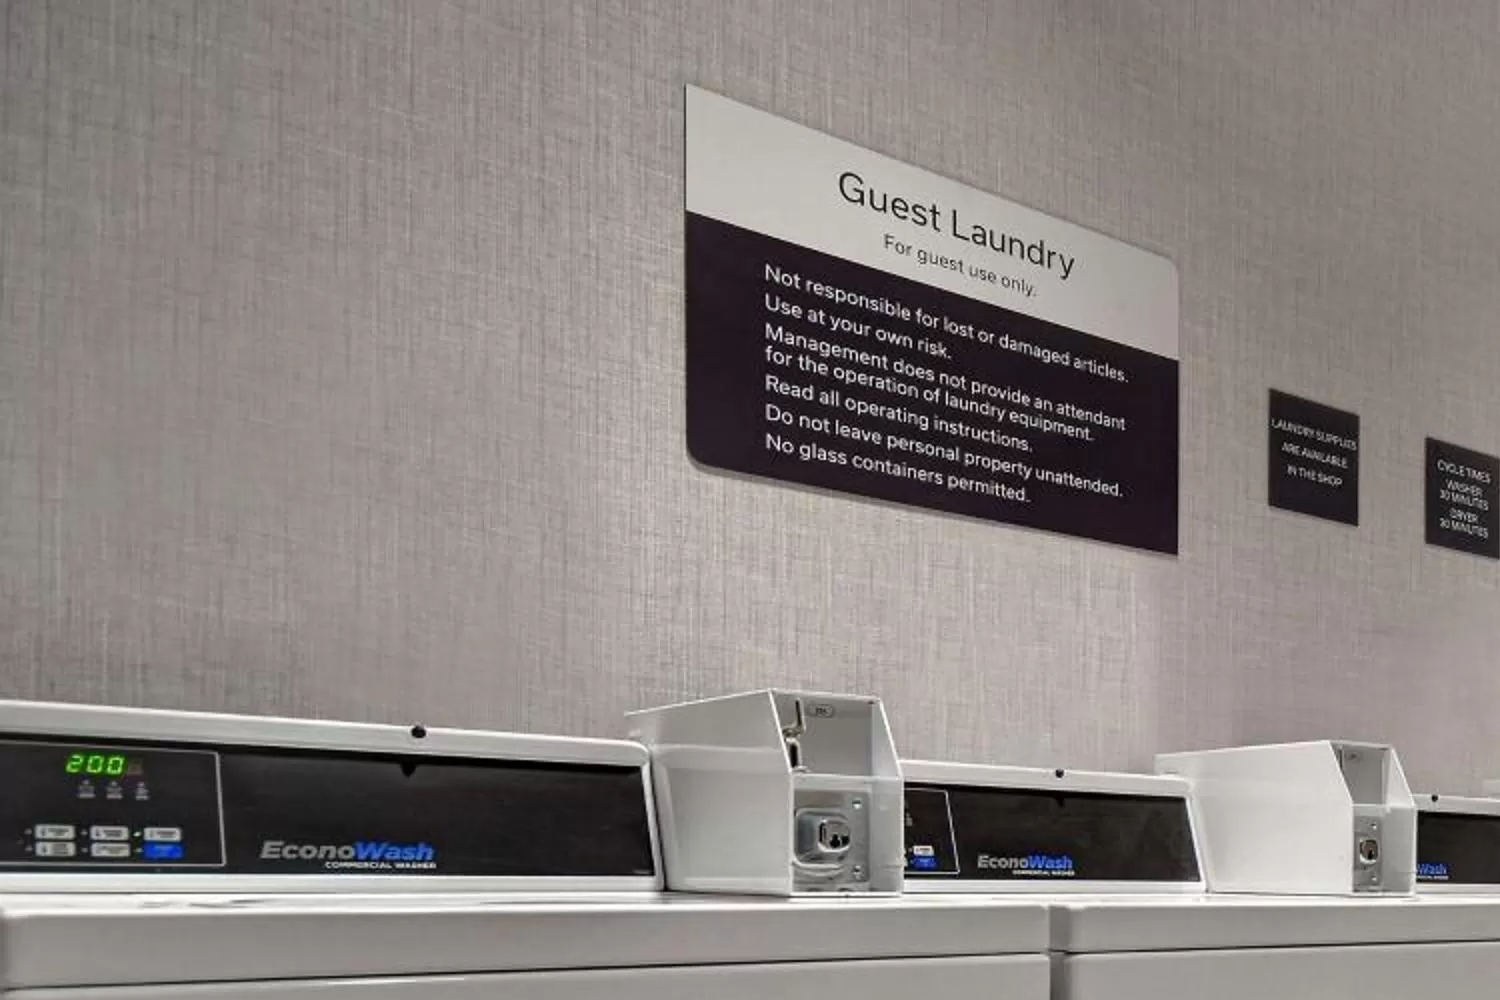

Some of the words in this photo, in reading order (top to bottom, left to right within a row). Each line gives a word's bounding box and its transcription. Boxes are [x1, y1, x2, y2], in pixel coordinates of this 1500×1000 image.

[838, 171, 941, 232] Guest
[951, 209, 1075, 280] Laundry
[883, 233, 912, 255] For
[917, 247, 965, 274] guest
[968, 264, 997, 284] use
[1001, 276, 1037, 297] only.
[765, 263, 801, 290] Not
[805, 279, 911, 321] responsible
[915, 307, 940, 329] for
[943, 315, 975, 340] lost
[977, 329, 994, 345] or
[999, 333, 1071, 366] damaged
[1073, 356, 1130, 383] articles.
[765, 293, 803, 318] Use
[807, 308, 826, 325] at
[829, 315, 872, 337] your
[875, 328, 913, 349] own
[917, 337, 952, 359] risk.
[765, 322, 889, 371] Management
[893, 358, 935, 382] does
[939, 371, 967, 391] not
[970, 380, 1031, 406] provide
[1033, 397, 1053, 412] an
[1055, 402, 1127, 432] attendant
[765, 345, 793, 367] for
[798, 354, 829, 376] the
[833, 367, 919, 399] operation
[923, 387, 941, 404] of
[945, 390, 1007, 423] laundry
[1008, 410, 1096, 441] equipment.
[765, 373, 814, 401] Read
[819, 389, 840, 407] all
[845, 397, 929, 431] operating
[933, 413, 1033, 452] instructions.
[1271, 417, 1314, 438] LAUNDRY
[1315, 429, 1357, 451] SUPPLIES
[765, 403, 794, 425] Do
[799, 414, 831, 433] not
[835, 419, 882, 445] leave
[886, 434, 960, 462] personal
[964, 451, 1033, 481] property
[1035, 467, 1124, 497] unattended.
[1281, 441, 1301, 457] ARE
[1301, 447, 1349, 469] AVAILABLE
[765, 433, 795, 454] No
[799, 442, 848, 465] glass
[852, 454, 944, 486] containers
[947, 473, 1032, 502] permitted.
[1298, 466, 1317, 481] THE
[1317, 472, 1343, 487] SHOP
[1436, 459, 1465, 477] CYCLE
[1465, 467, 1491, 485] TIMES
[1445, 478, 1484, 498] WASHER
[1451, 491, 1489, 511] MINUTES
[1451, 520, 1489, 539] MINUTES
[65, 754, 125, 775] 200
[259, 839, 434, 861] EconoWash
[324, 861, 393, 870] COMMERCIAL
[977, 854, 1073, 869] EconoWash
